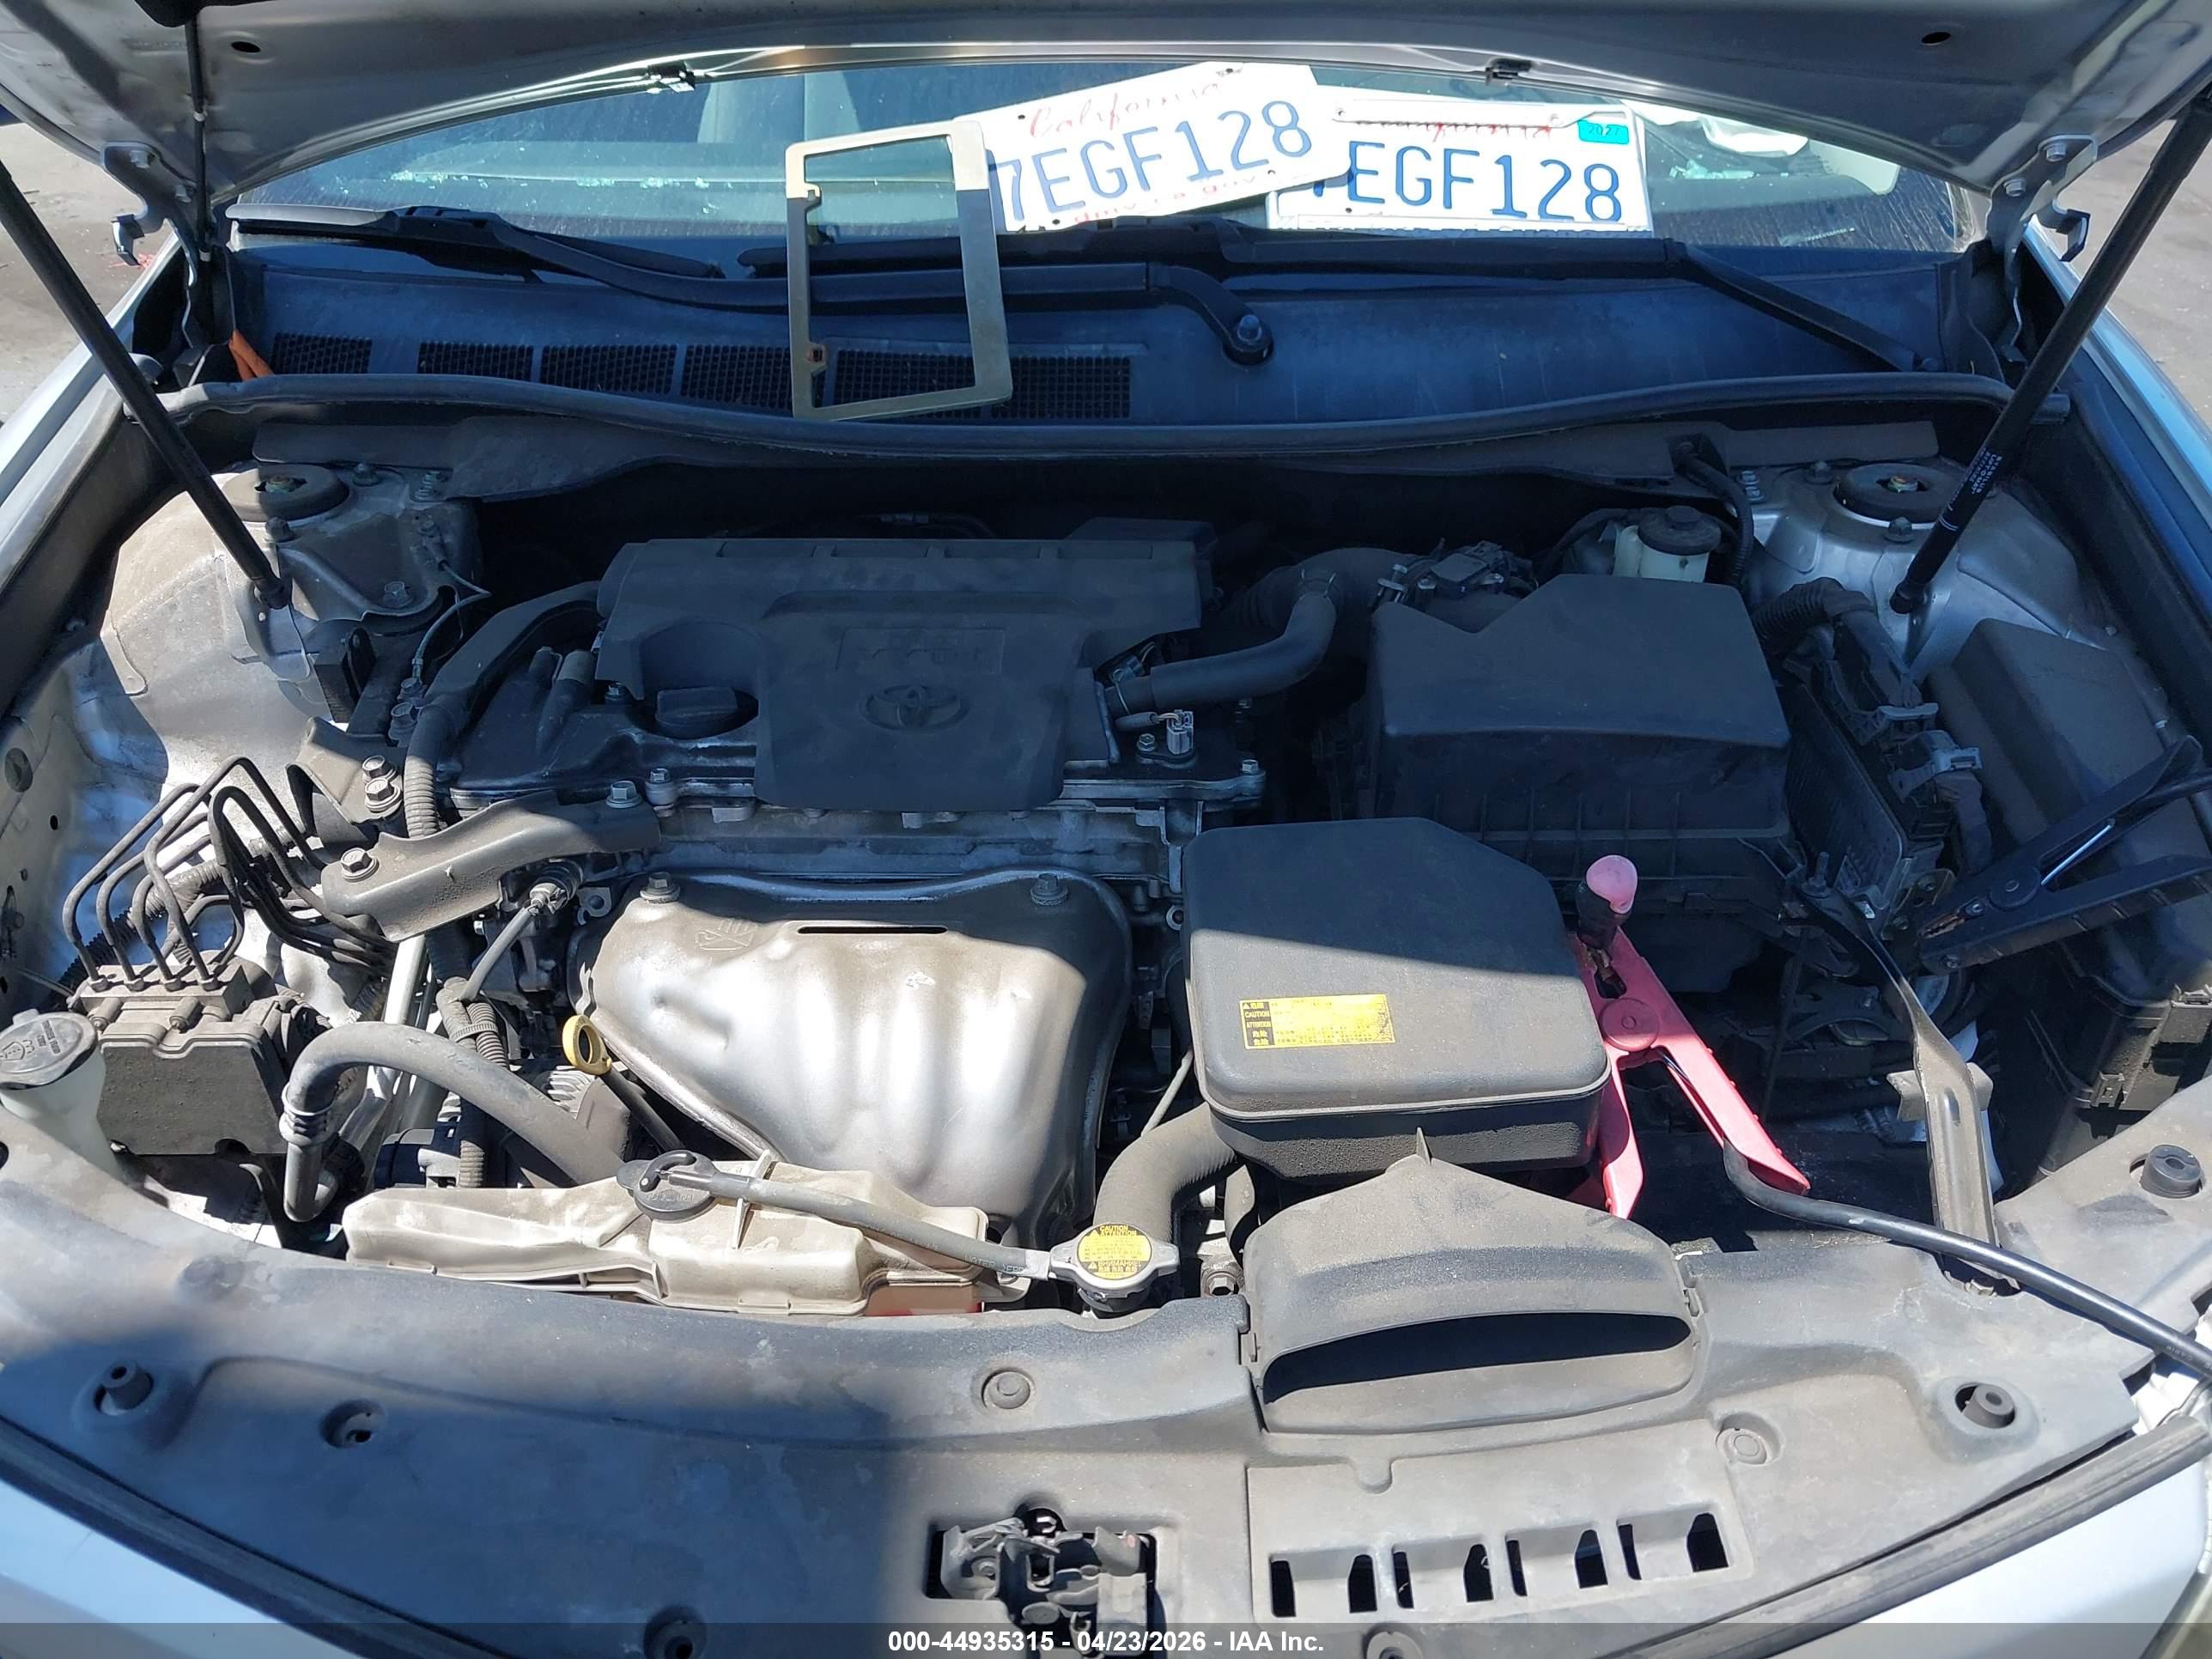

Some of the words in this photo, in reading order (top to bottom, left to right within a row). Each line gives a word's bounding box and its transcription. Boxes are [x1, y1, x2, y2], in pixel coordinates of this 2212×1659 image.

[989, 100, 1312, 222] 7EGF128
[1313, 140, 1622, 222] EGF128
[964, 1255, 996, 1268] WATER
